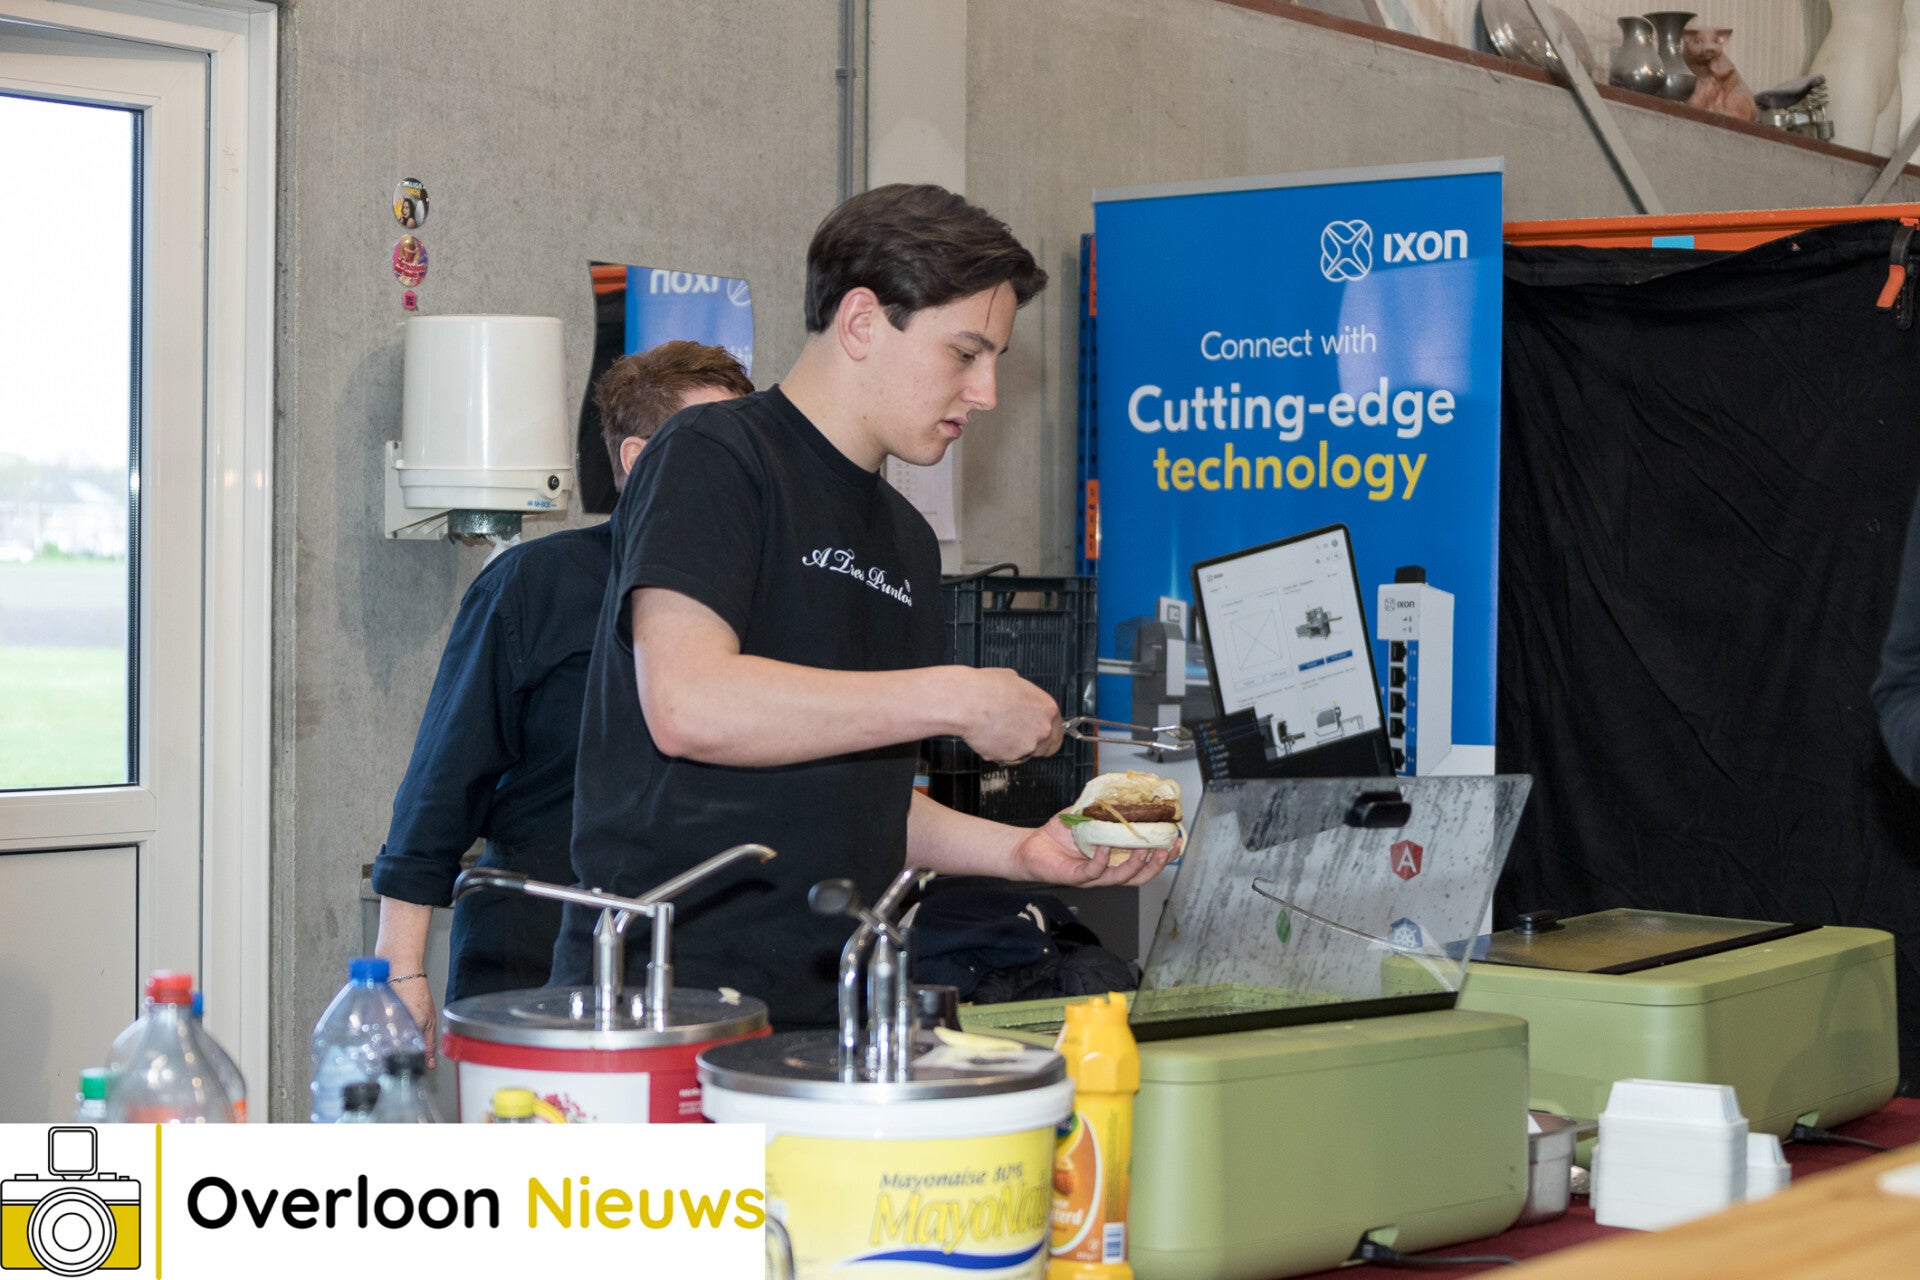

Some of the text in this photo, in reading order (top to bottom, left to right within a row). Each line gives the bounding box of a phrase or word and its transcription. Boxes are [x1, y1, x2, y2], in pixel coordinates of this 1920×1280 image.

[1200, 324, 1377, 361] Connect with
[1127, 376, 1456, 442] Cutting-edge
[1153, 440, 1427, 501] technology
[801, 547, 833, 568] A
